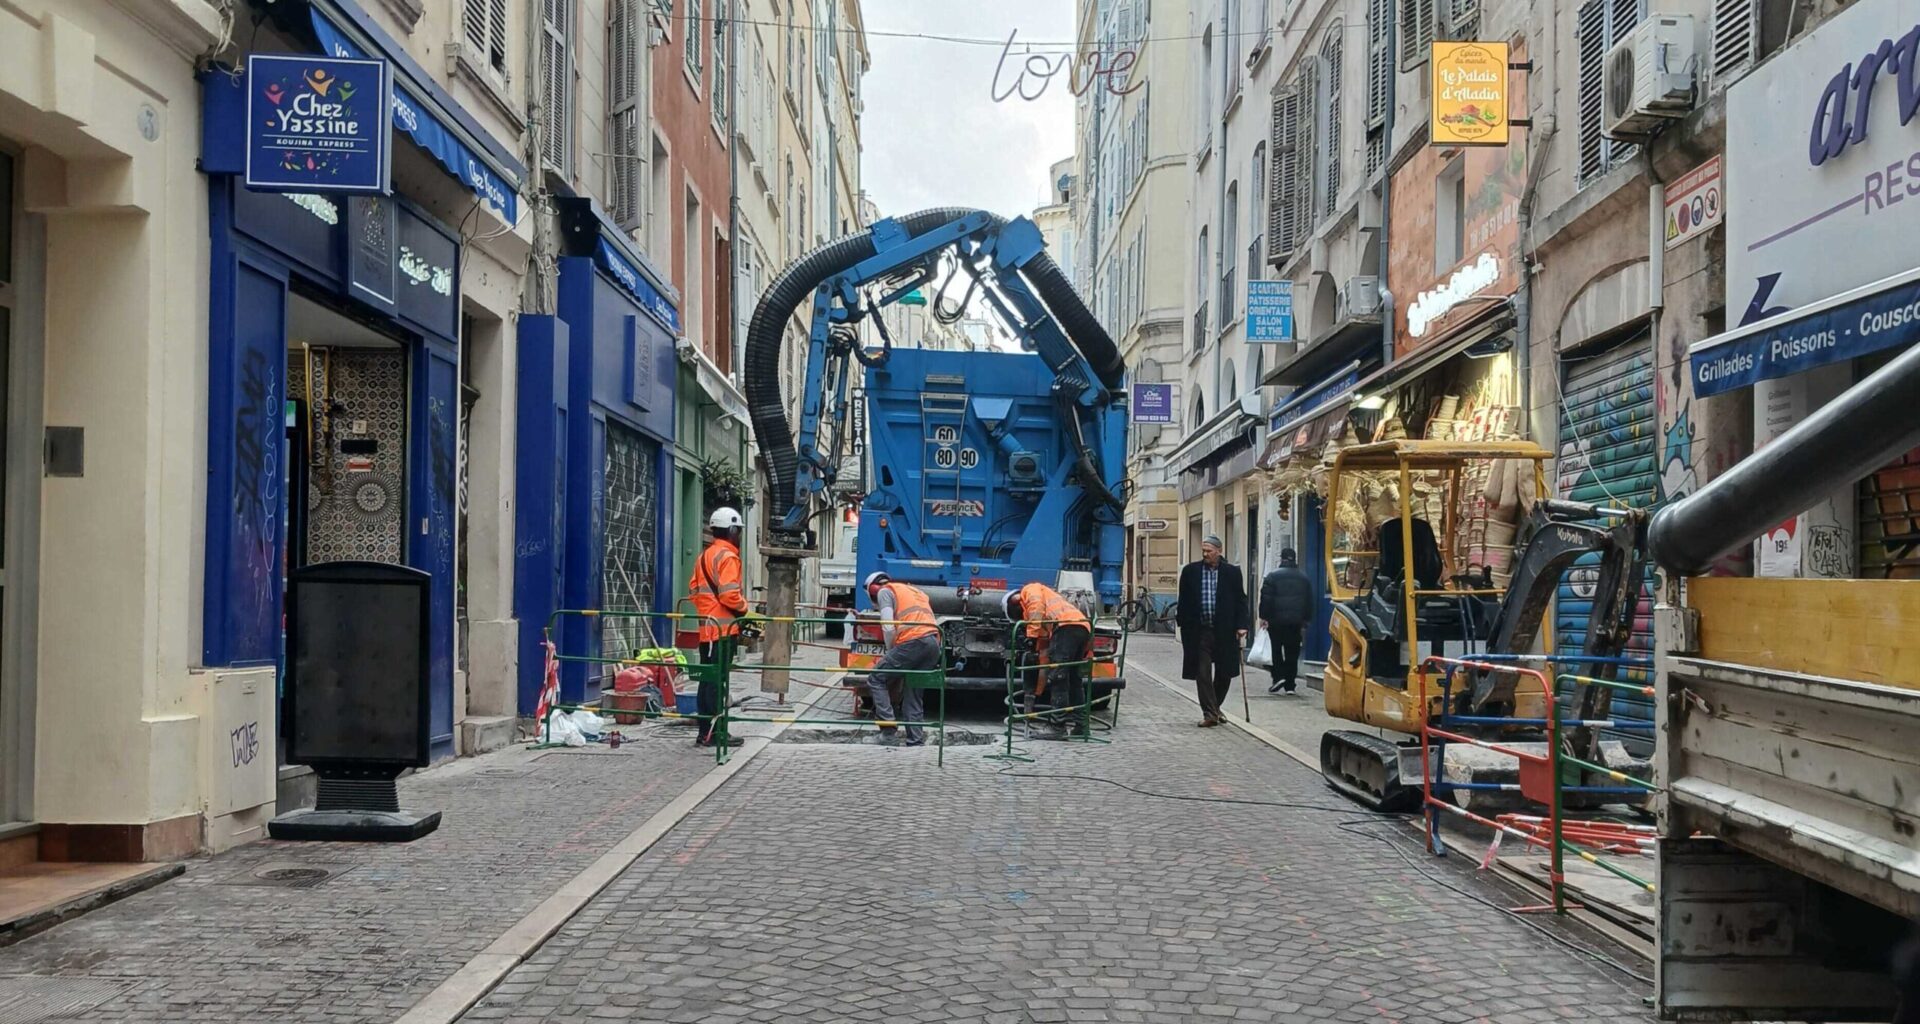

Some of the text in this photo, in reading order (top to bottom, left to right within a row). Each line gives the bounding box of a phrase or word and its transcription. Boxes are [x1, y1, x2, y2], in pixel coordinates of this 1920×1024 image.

[991, 28, 1145, 102] love
[1441, 67, 1498, 86] Le Palais
[1442, 86, 1499, 102] d'Aladin
[293, 93, 343, 117] Chez
[391, 94, 418, 131] PRESS
[276, 108, 358, 135] Yassine
[276, 138, 355, 148] KOUJINA EXPRESS
[468, 159, 505, 208] Chez Yassine
[1249, 296, 1290, 306] PATISSERIE
[1249, 306, 1290, 316] ORIENTALE
[1255, 316, 1282, 326] SALON
[1255, 326, 1266, 336] DE
[1698, 352, 1753, 383] Grillades
[1771, 329, 1836, 362] Poissons
[854, 400, 863, 455] RESTAU
[938, 428, 953, 441] 60
[937, 449, 953, 465] 80
[961, 450, 977, 466] 90
[940, 502, 976, 512] SERVICE
